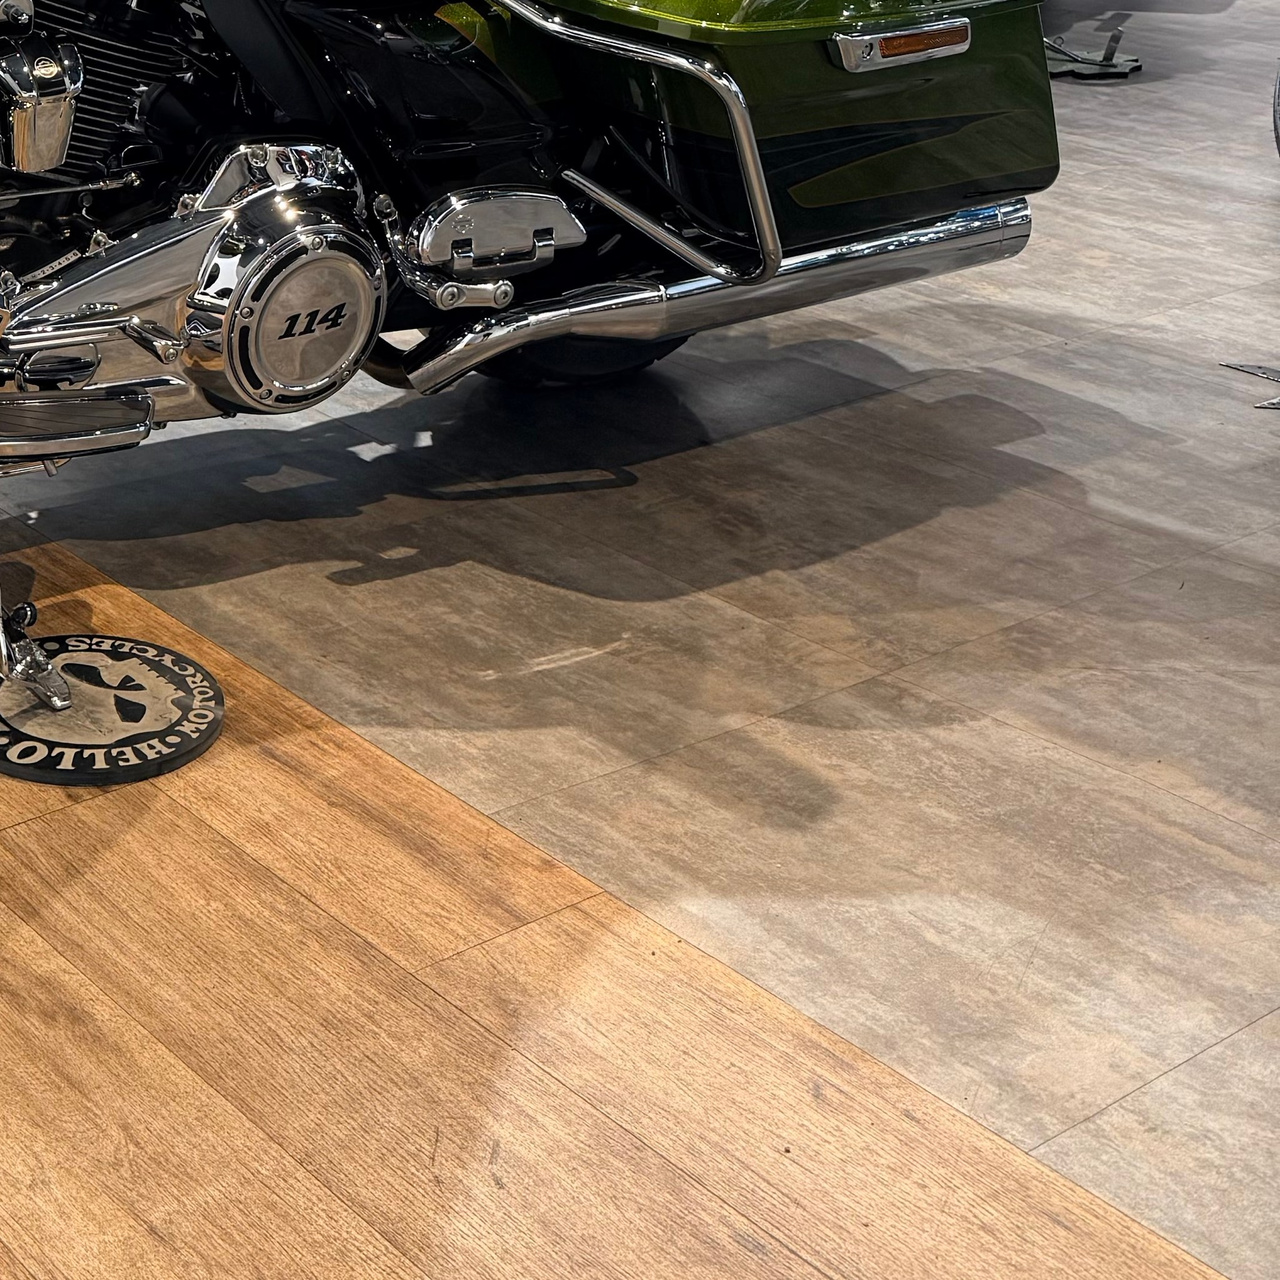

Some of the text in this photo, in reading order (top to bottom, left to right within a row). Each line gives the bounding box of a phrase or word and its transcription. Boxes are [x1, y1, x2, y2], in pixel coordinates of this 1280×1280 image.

[277, 302, 348, 340] 114
[65, 636, 216, 739] MOTORCYCLES
[6, 737, 177, 770] HELLO
